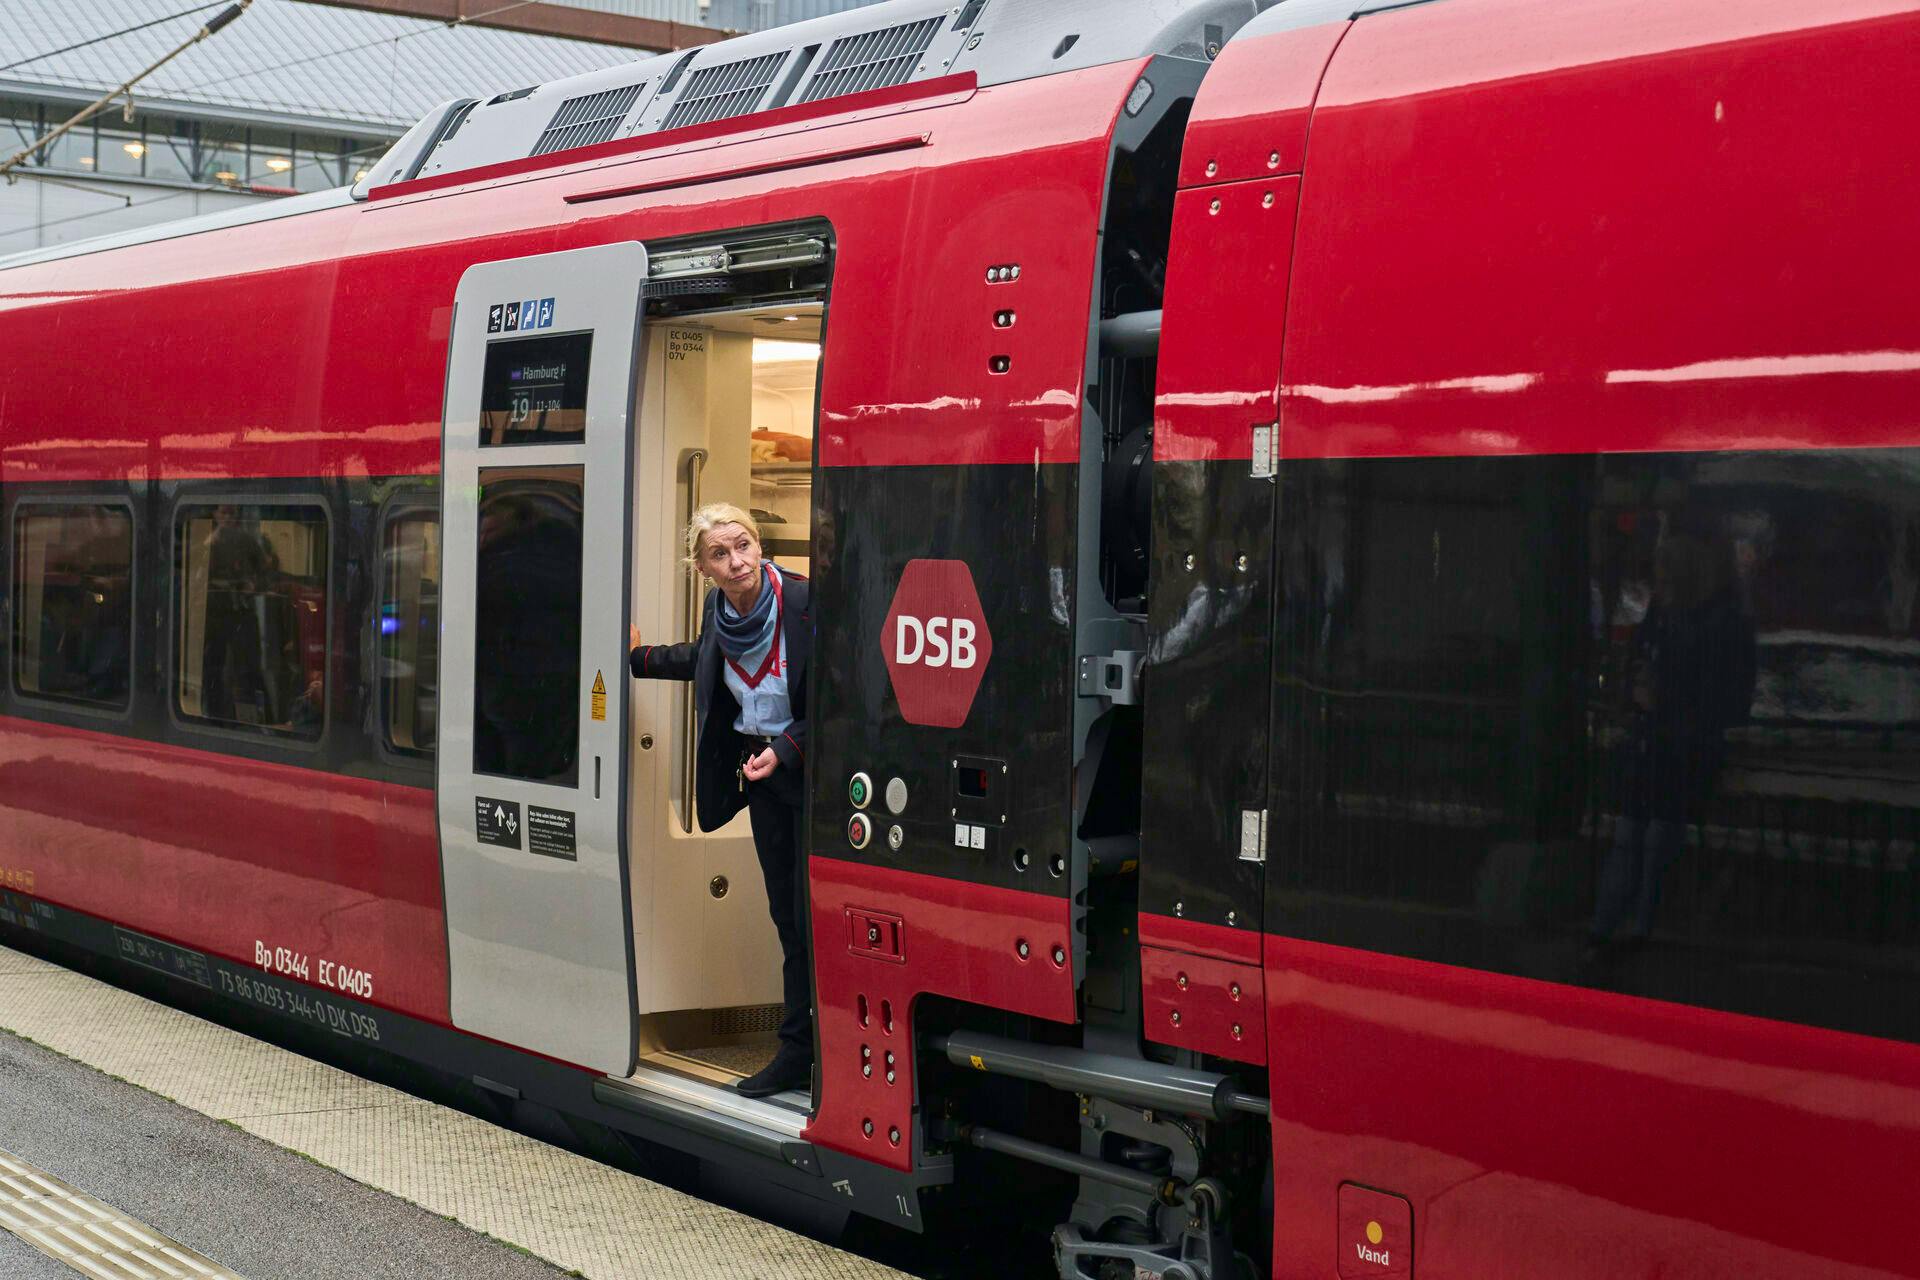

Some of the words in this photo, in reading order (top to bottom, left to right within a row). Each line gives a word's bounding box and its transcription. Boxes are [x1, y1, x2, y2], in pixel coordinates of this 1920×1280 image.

[670, 330, 681, 340] EC
[682, 331, 703, 341] 0405
[670, 342, 681, 351] Bp
[683, 343, 704, 352] 0344
[669, 352, 686, 361] 07V
[522, 364, 559, 380] Hamburg
[511, 398, 529, 422] 19
[896, 615, 977, 669] DSB
[255, 940, 273, 973] Bp
[275, 946, 309, 981] 0344
[319, 959, 335, 987] EC
[338, 965, 373, 998] 0405
[217, 968, 234, 993] 73
[235, 974, 252, 999] 86
[253, 980, 285, 1010] 8293
[286, 991, 326, 1023] 344-0
[327, 1004, 351, 1032] DK
[350, 1011, 380, 1041] DSB
[1356, 1243, 1390, 1266] Vand
